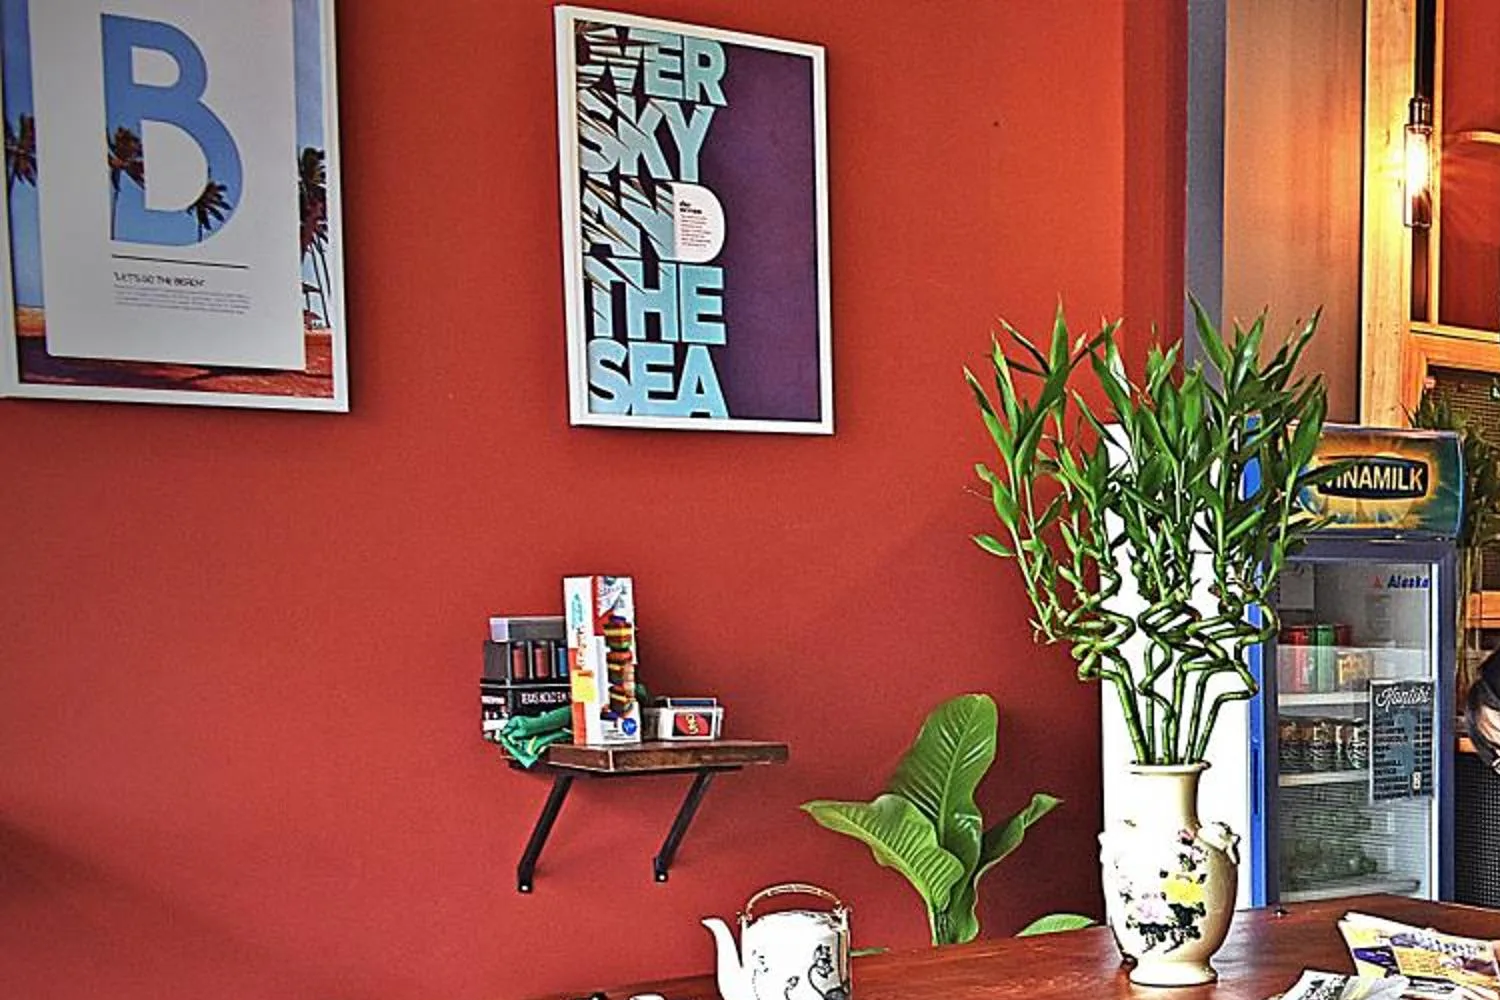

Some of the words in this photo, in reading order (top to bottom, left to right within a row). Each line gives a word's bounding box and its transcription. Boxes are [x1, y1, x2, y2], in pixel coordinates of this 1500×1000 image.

[100, 13, 243, 246] B
[577, 88, 716, 182] SKY
[584, 256, 726, 344] THE
[588, 338, 730, 418] SEA
